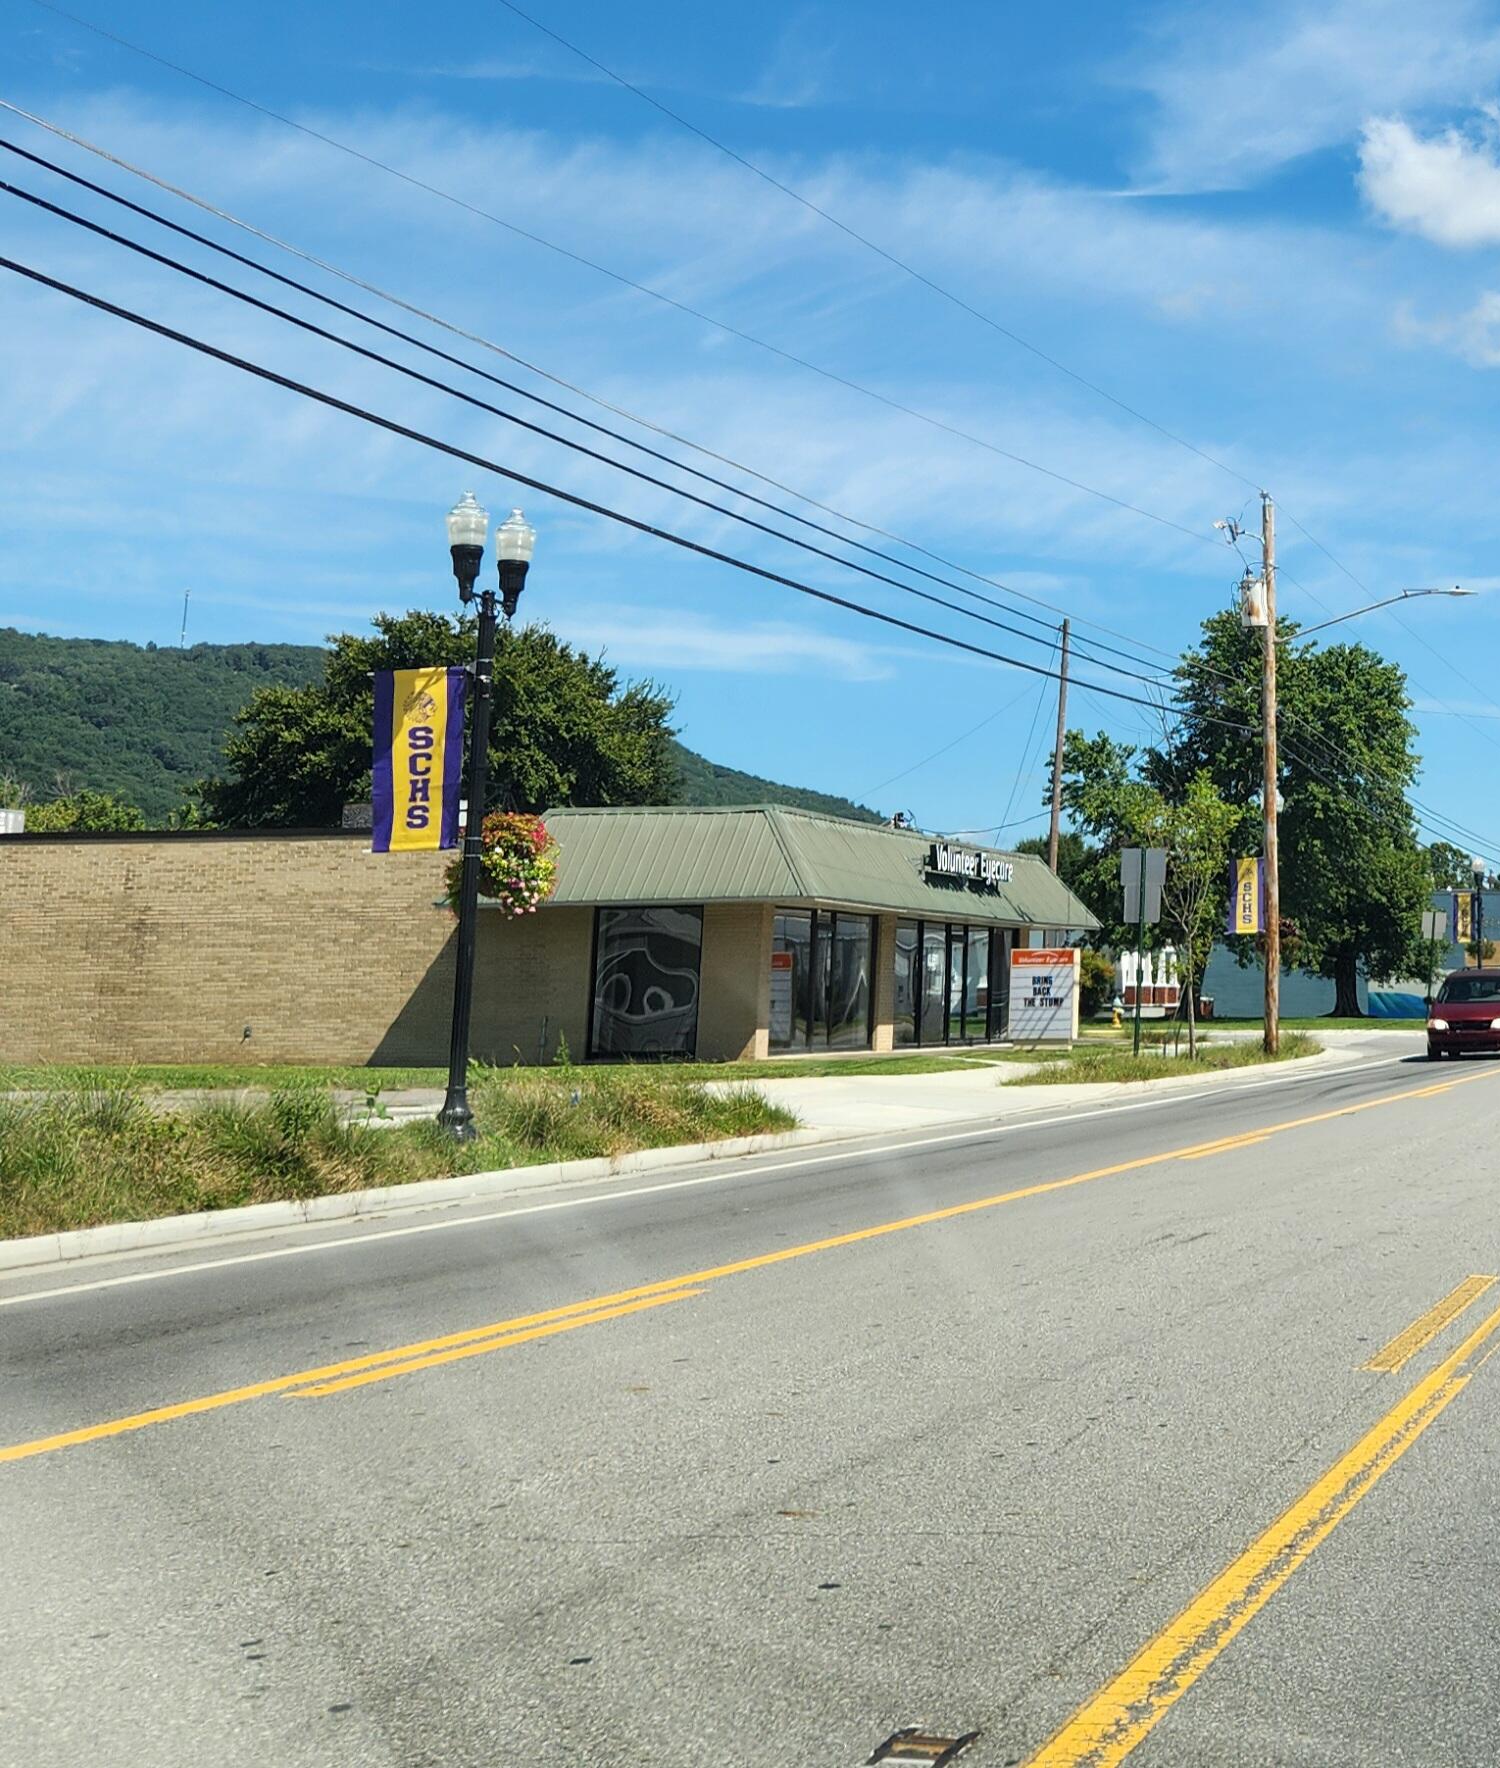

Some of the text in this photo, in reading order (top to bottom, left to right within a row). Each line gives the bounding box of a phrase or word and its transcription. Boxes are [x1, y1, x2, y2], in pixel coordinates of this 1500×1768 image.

[406, 726, 434, 829] SCHS
[936, 843, 1014, 885] Volunteer Eyecare
[1243, 882, 1252, 924] SCHS
[1032, 976, 1053, 986] BRING
[1033, 987, 1051, 996] BACK
[1024, 997, 1064, 1007] THE STUMP
